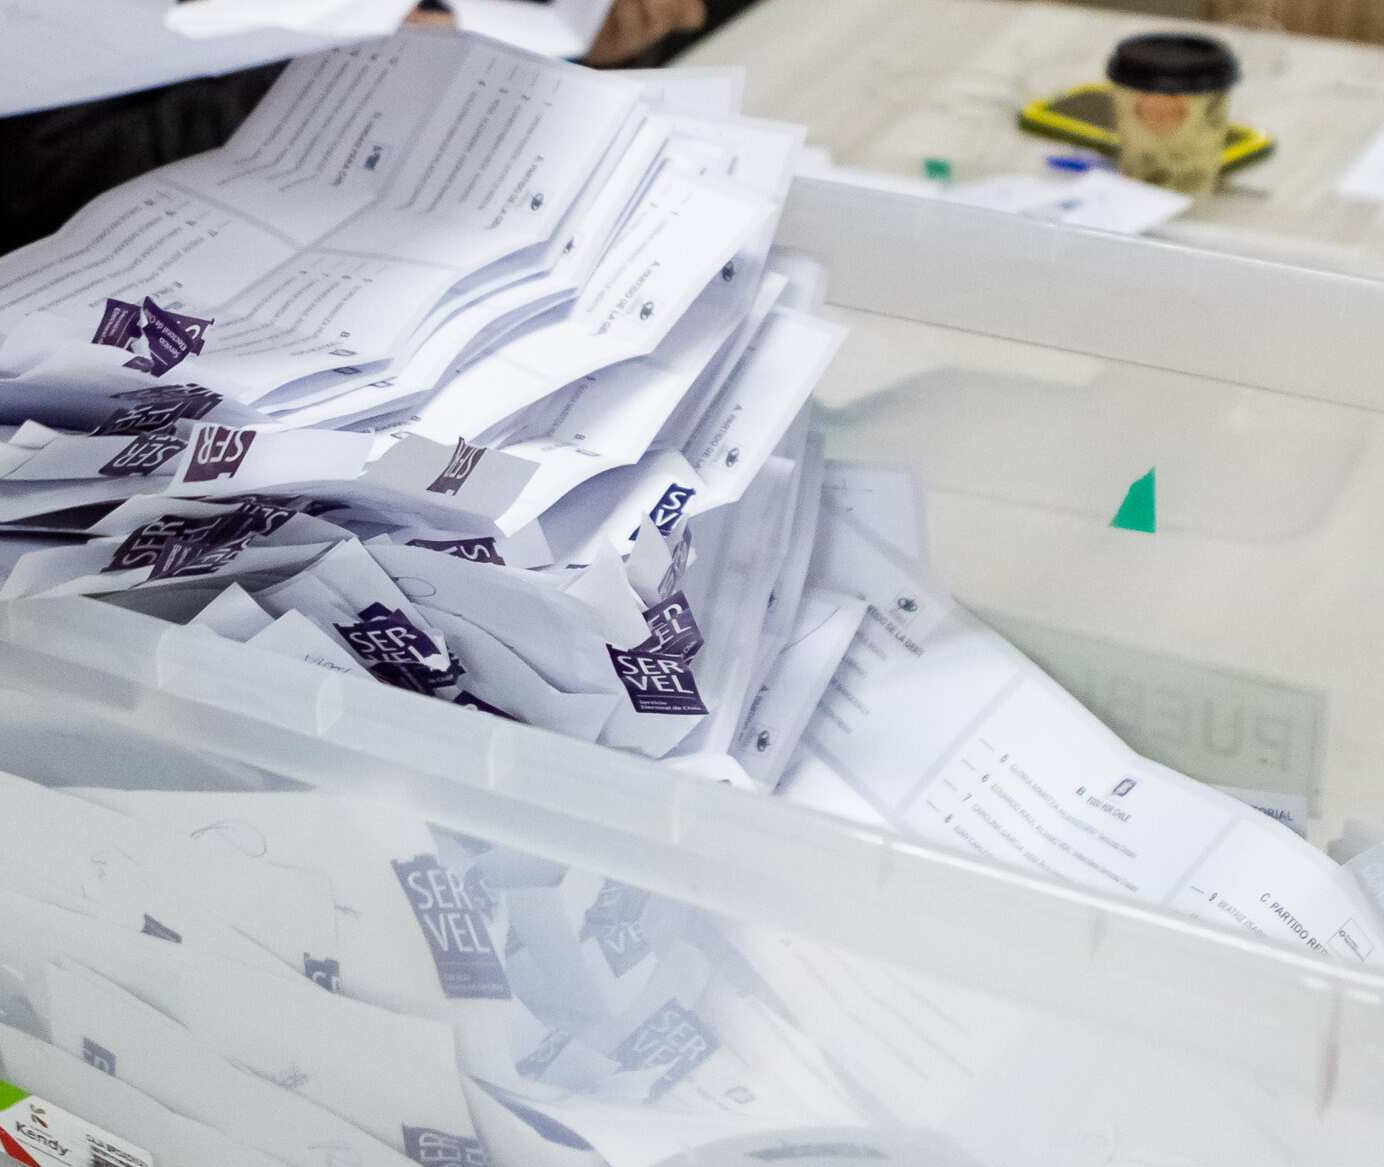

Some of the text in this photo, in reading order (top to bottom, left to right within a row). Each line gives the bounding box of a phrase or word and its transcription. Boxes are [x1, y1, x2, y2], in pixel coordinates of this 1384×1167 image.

[198, 425, 245, 464] SER
[349, 627, 418, 654] SER
[617, 656, 684, 675] SER
[625, 675, 694, 694] VEL
[408, 869, 473, 911] SER
[423, 913, 490, 953] VEL
[1269, 901, 1309, 940] PARTIDO
[15, 1120, 70, 1157] Kendy
